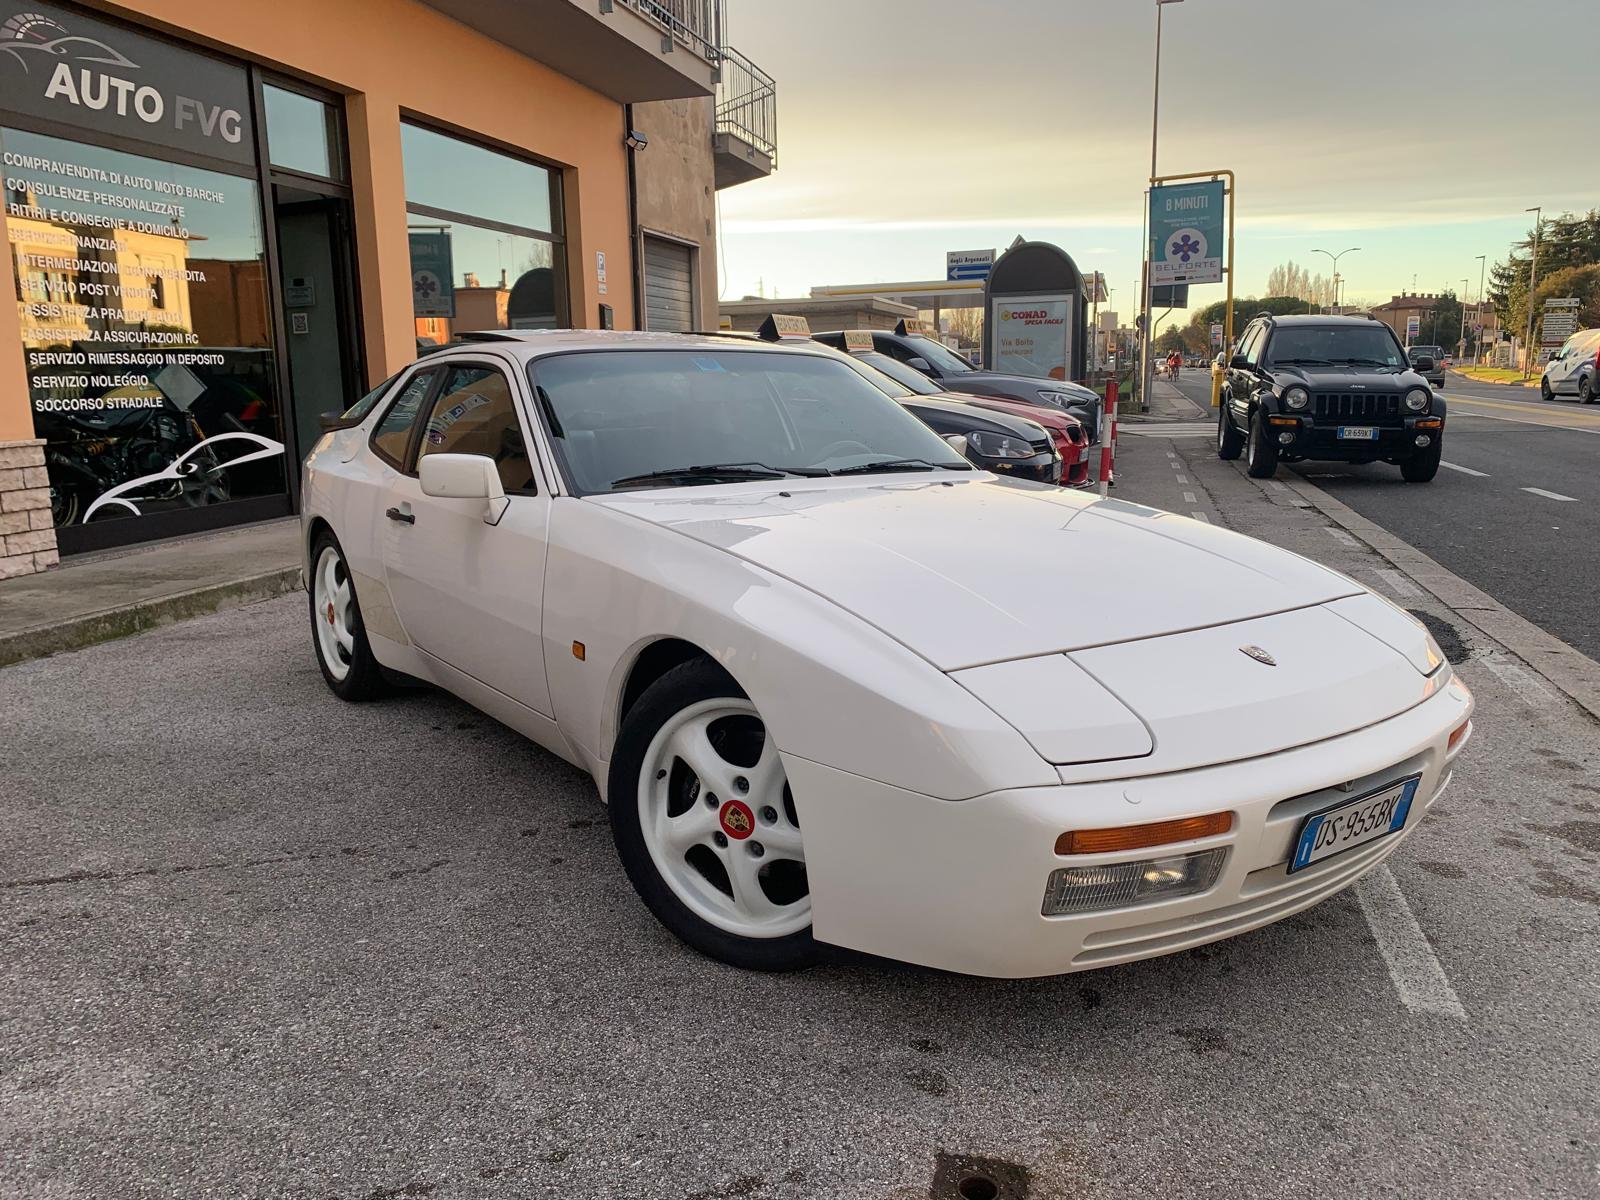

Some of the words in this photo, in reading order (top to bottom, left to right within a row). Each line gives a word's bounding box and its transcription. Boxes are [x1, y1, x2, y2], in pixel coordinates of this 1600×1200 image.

[44, 62, 164, 123] AUTO
[175, 95, 242, 143] FVG
[4, 152, 107, 183] COMPRAVENDITA
[110, 173, 121, 184] DI
[123, 175, 152, 190] AUTO
[154, 181, 185, 196] MOTO
[186, 187, 225, 204] BARCHE
[7, 178, 90, 202] CONSULENZE
[93, 191, 185, 218] PERSONALIZZATE
[1174, 195, 1209, 210] MINUTI
[10, 203, 48, 220] RITIRI
[50, 208, 59, 222] E
[61, 210, 125, 230] CONSEGNE
[127, 219, 137, 232] A
[137, 221, 189, 239] DOMICILIO
[18, 254, 124, 276] INTERMEDIAZION
[1155, 260, 1217, 271] BELFORTE
[21, 280, 77, 293] SERVIZIO
[79, 282, 110, 296] POST
[112, 285, 158, 300] VENDITA
[25, 304, 98, 319] ASSISTENZA
[101, 308, 153, 322] PRATICHE
[1011, 310, 1047, 319] CONAD
[27, 328, 101, 342] ASSISTENZA
[103, 330, 183, 344] ASSICURAZIONI
[186, 334, 199, 345] RC
[1002, 338, 1012, 346] Via
[1016, 338, 1034, 346] Boito
[29, 352, 86, 365] SERVIZIO
[88, 353, 164, 365] RIMESSAGGIO
[166, 353, 176, 364] IN
[178, 353, 225, 365] DEPOSITO
[32, 375, 88, 388] SERVIZIO
[91, 375, 149, 388] NOLEGGIO
[35, 399, 104, 412] SOCCORSO
[106, 397, 163, 410] STRADALE
